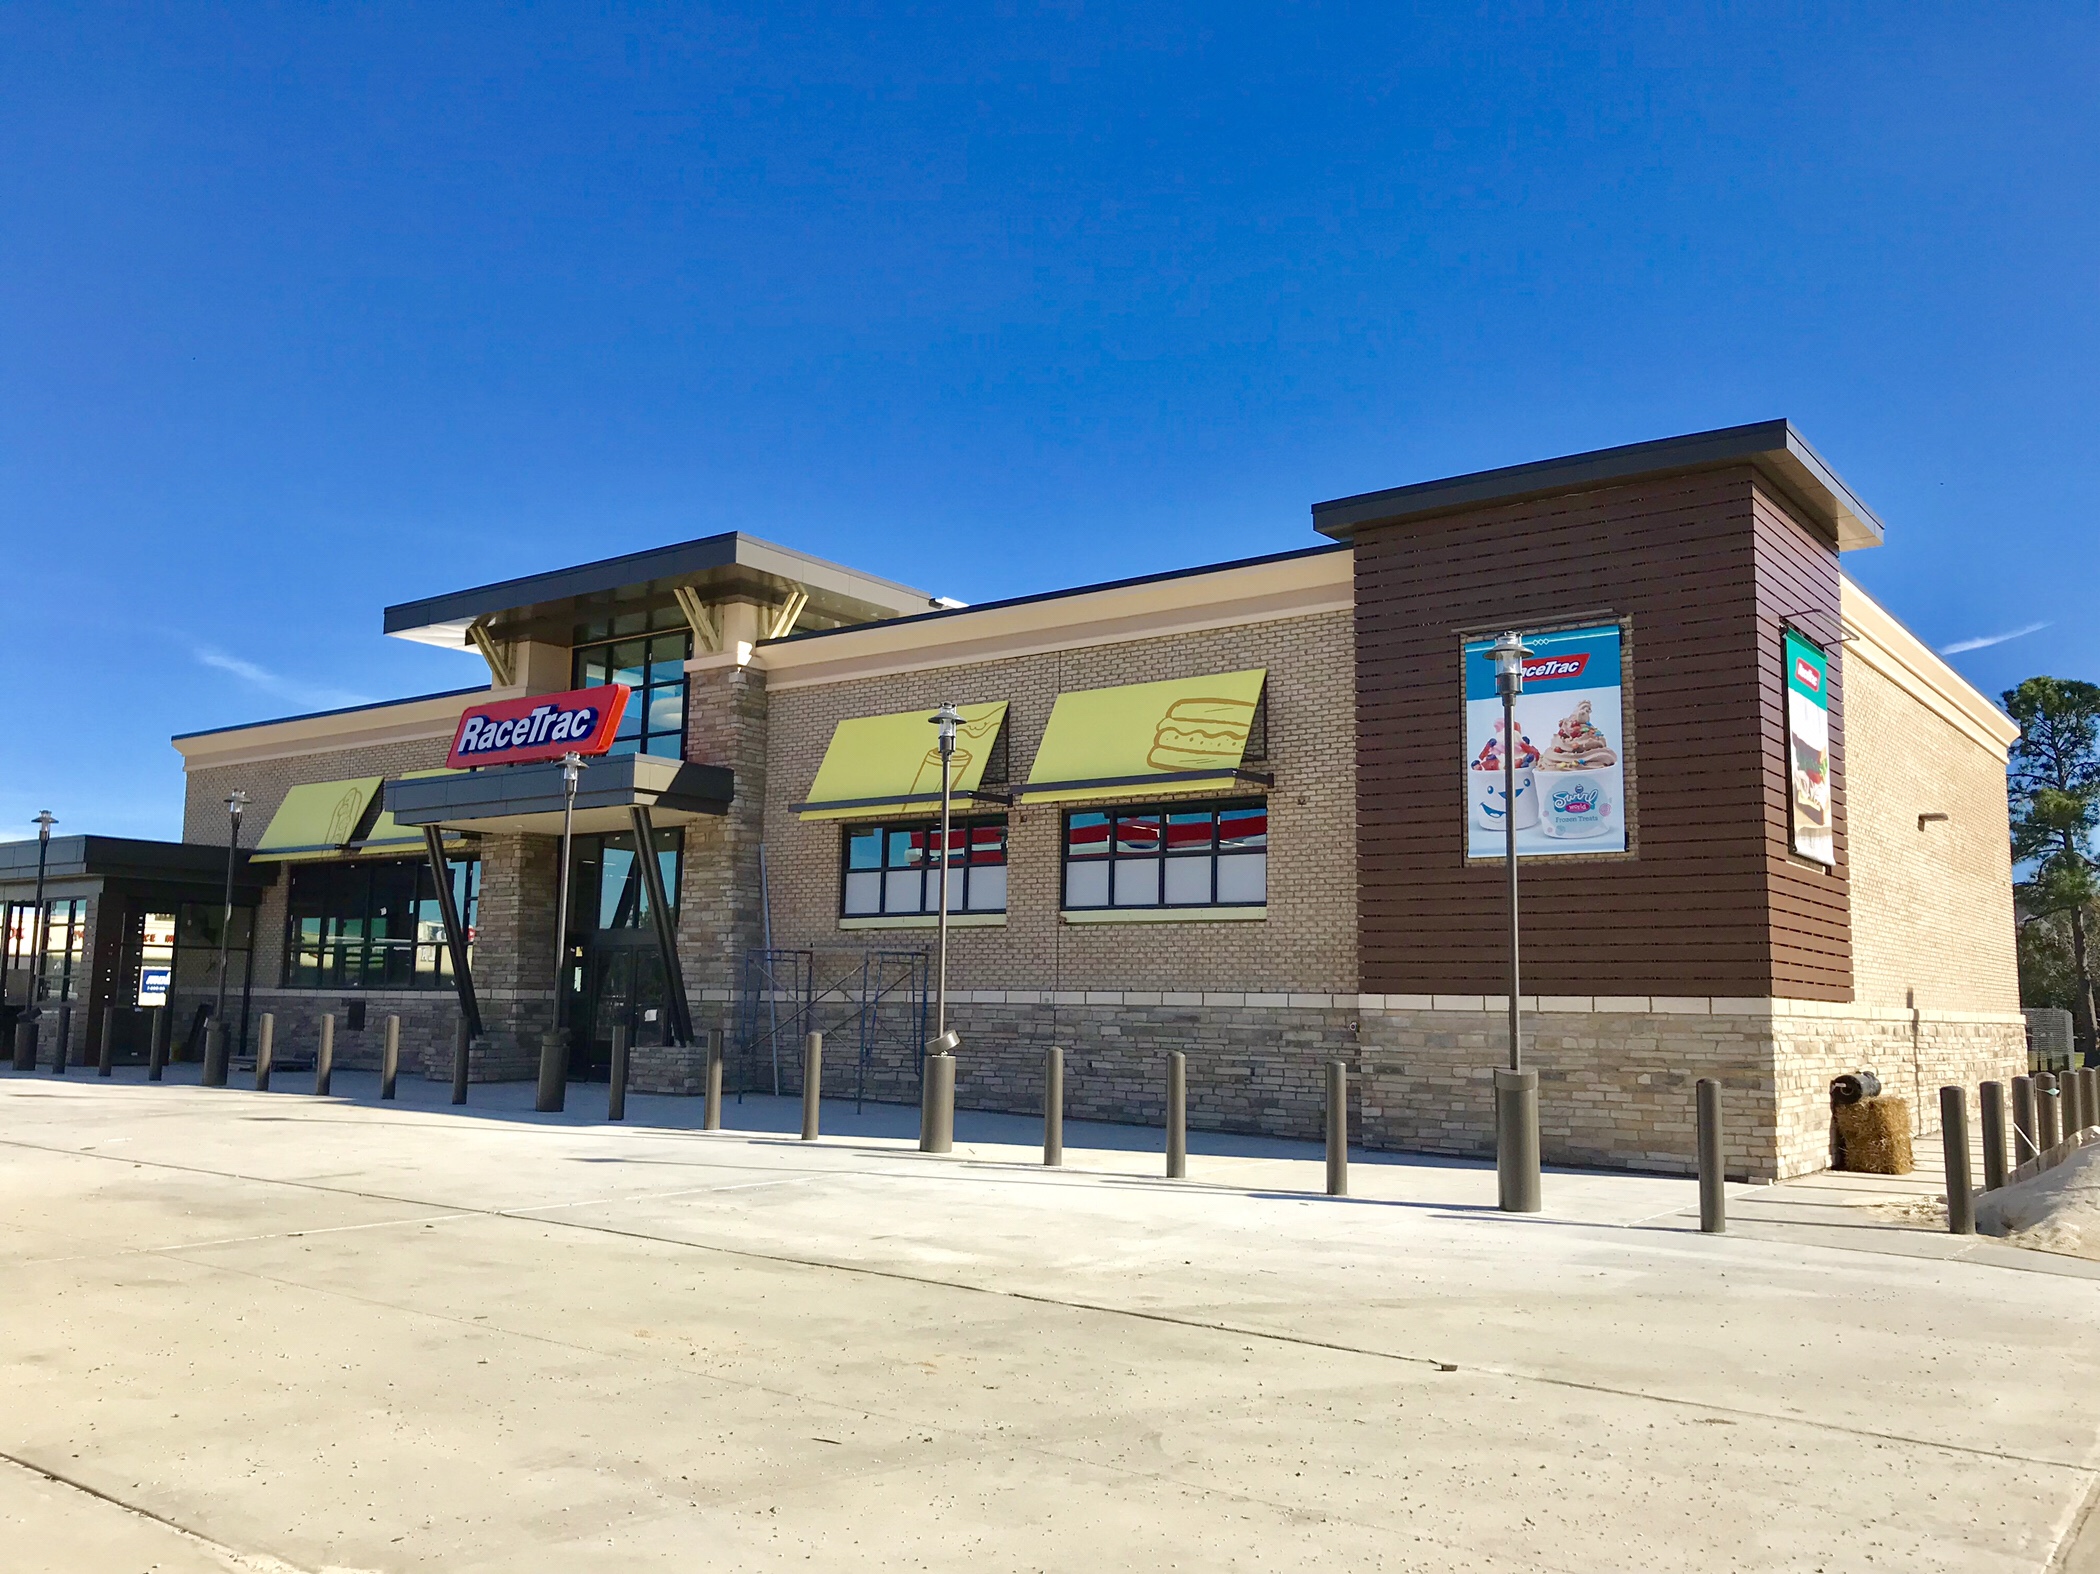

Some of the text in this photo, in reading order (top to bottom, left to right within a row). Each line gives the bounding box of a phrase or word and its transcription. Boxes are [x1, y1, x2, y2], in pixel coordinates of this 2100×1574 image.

[1522, 660, 1580, 678] ceTrac
[457, 704, 597, 755] RaceTrac
[1552, 789, 1598, 811] Swirl
